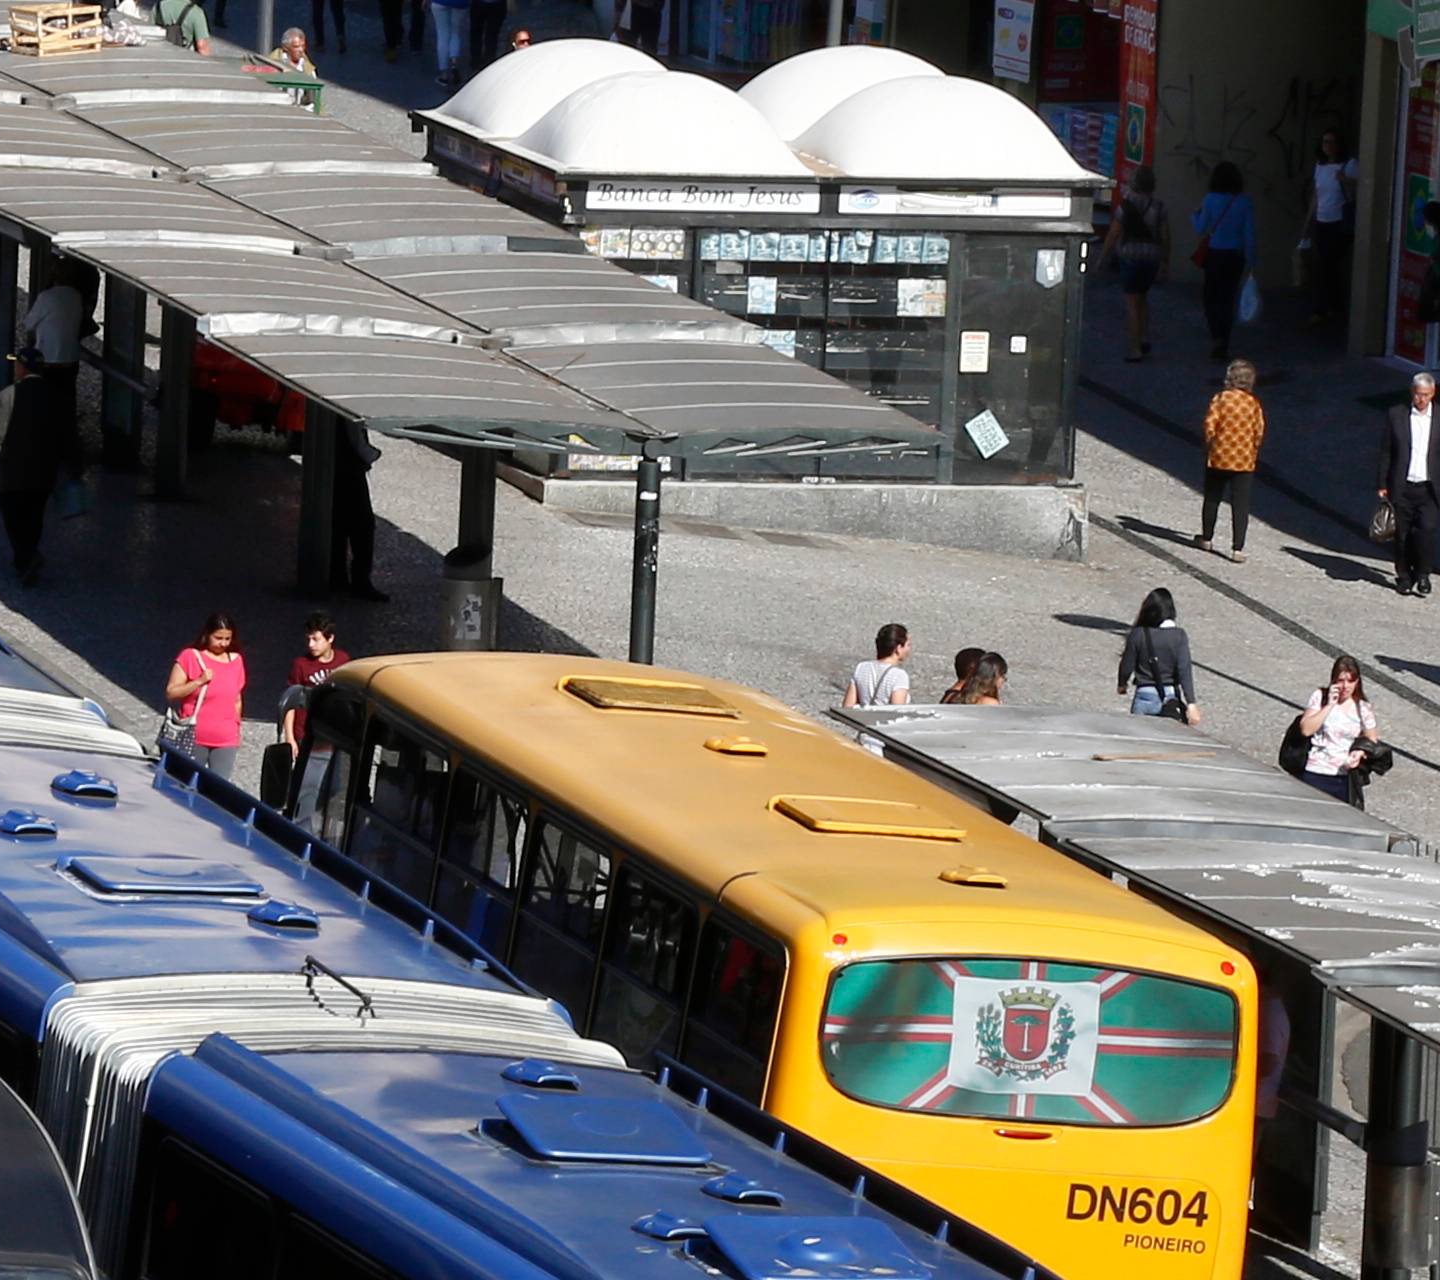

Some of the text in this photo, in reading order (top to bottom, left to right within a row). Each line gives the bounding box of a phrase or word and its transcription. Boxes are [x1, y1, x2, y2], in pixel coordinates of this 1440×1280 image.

[597, 182, 804, 209] Banca Bom Jesus
[1065, 1182, 1210, 1229] DN604
[1123, 1234, 1207, 1257] PIONEIRO
